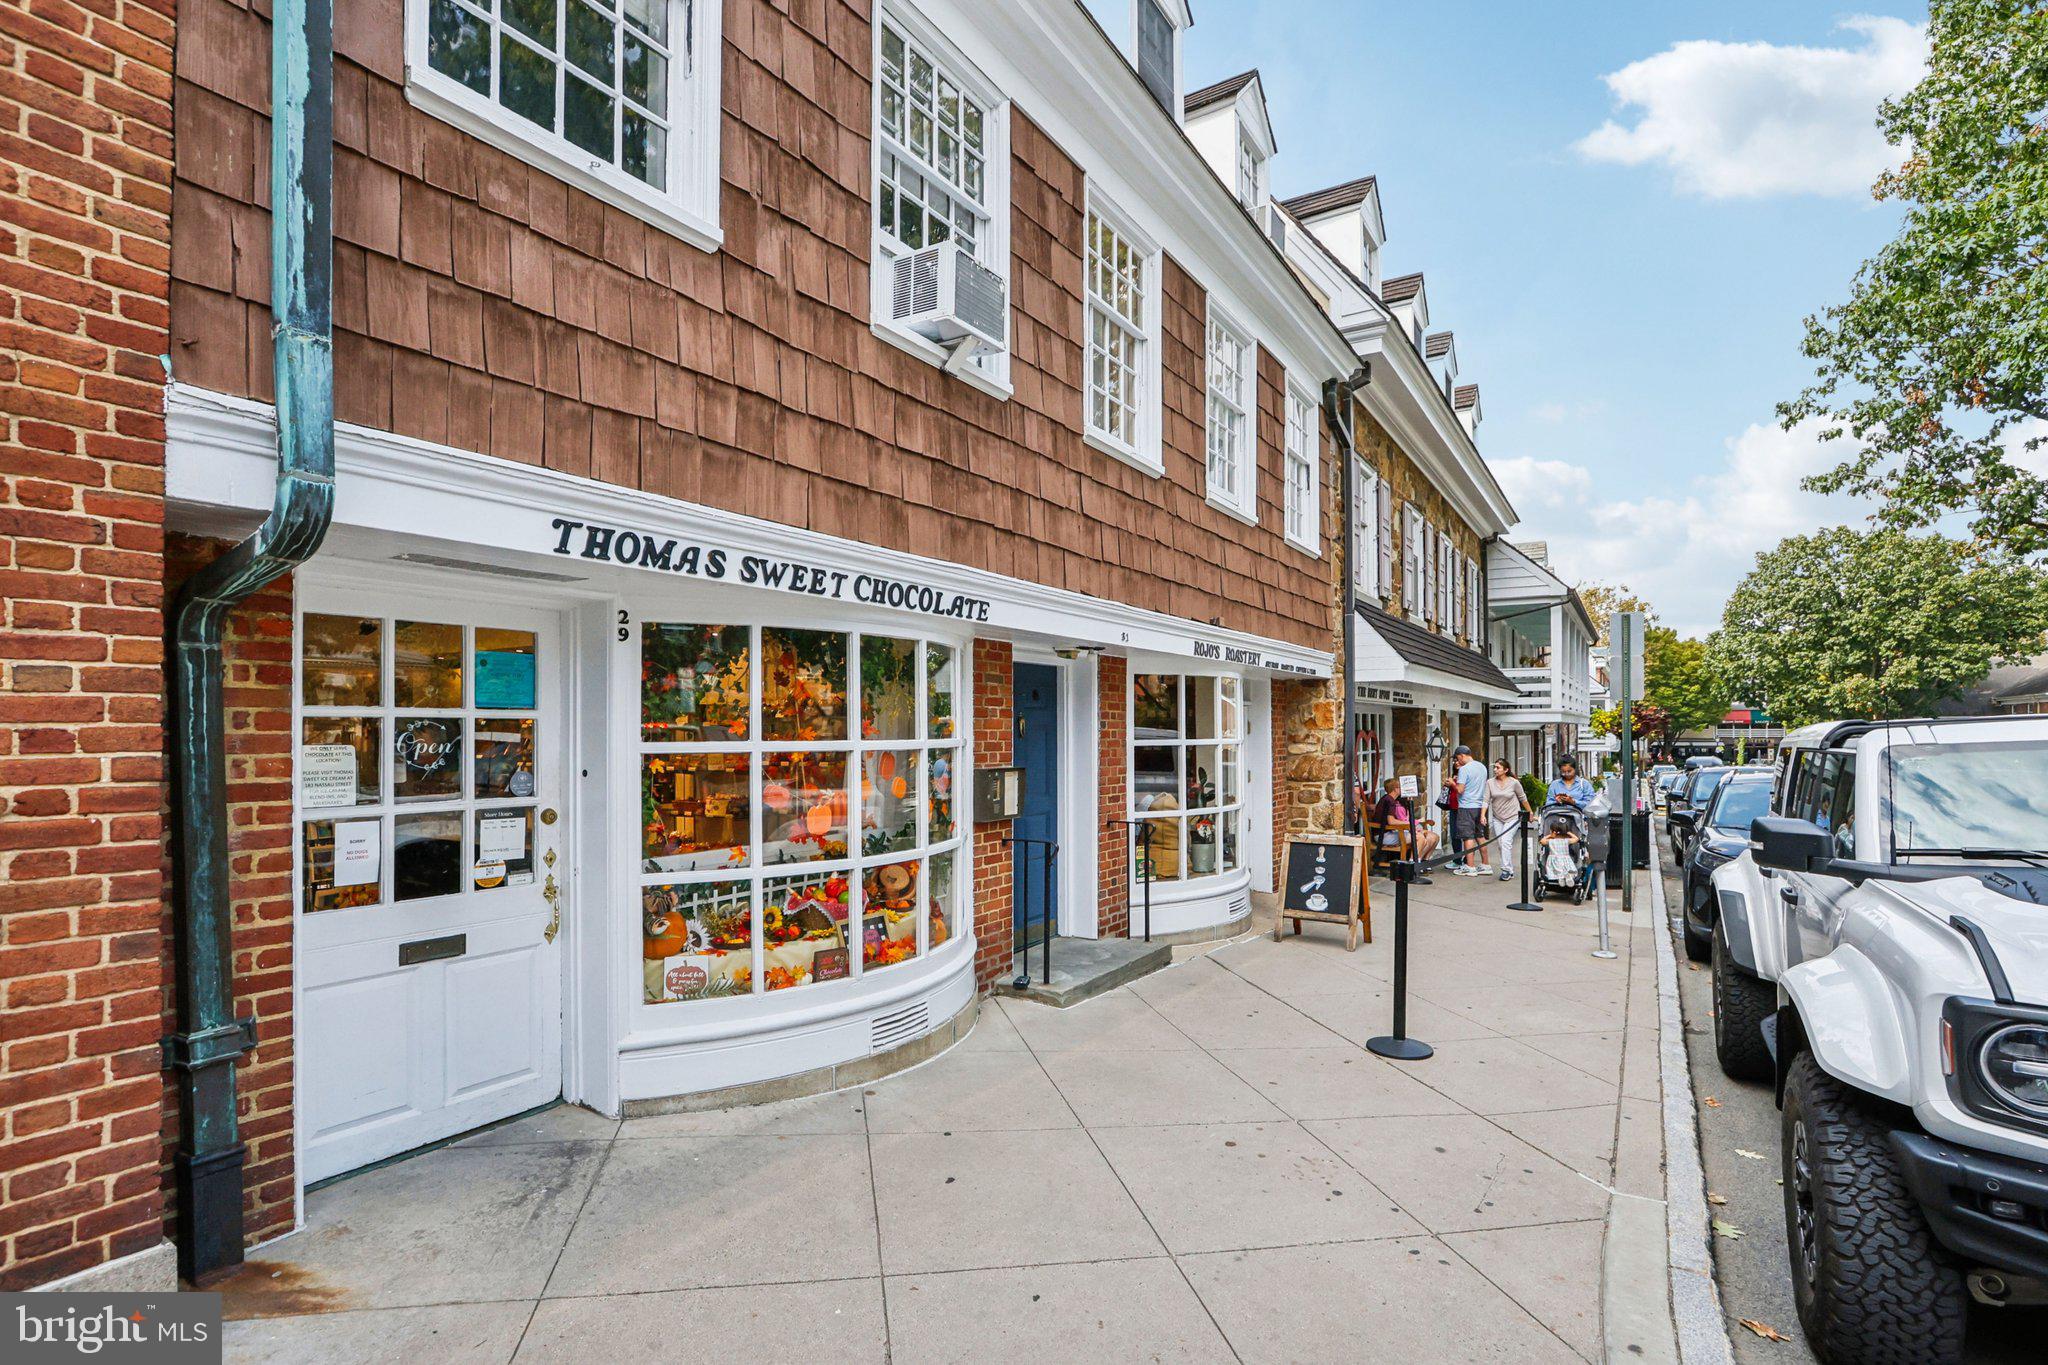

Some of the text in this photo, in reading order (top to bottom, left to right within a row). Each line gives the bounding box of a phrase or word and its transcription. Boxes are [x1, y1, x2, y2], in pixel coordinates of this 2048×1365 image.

[552, 518, 990, 622] THOMAS SWEET CHOCOLATE
[1193, 641, 1221, 660] ROJO'S
[1225, 646, 1262, 667] ROASTERY
[396, 731, 457, 760] Open
